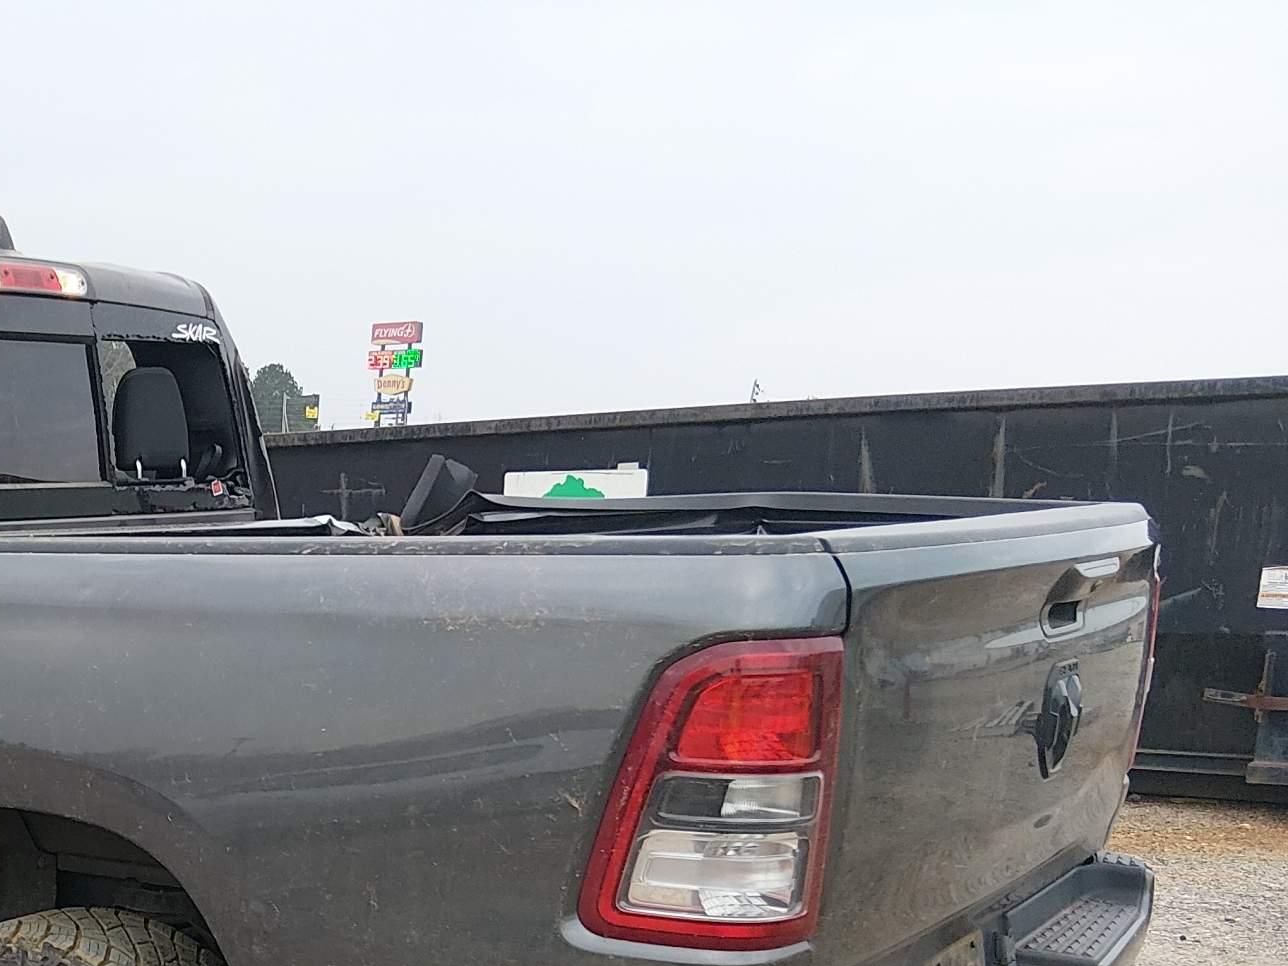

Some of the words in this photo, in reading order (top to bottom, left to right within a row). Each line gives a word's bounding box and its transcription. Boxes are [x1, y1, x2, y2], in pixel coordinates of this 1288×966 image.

[172, 323, 221, 344] SKAR
[374, 326, 405, 338] FLYING
[377, 379, 405, 391] Denny's
